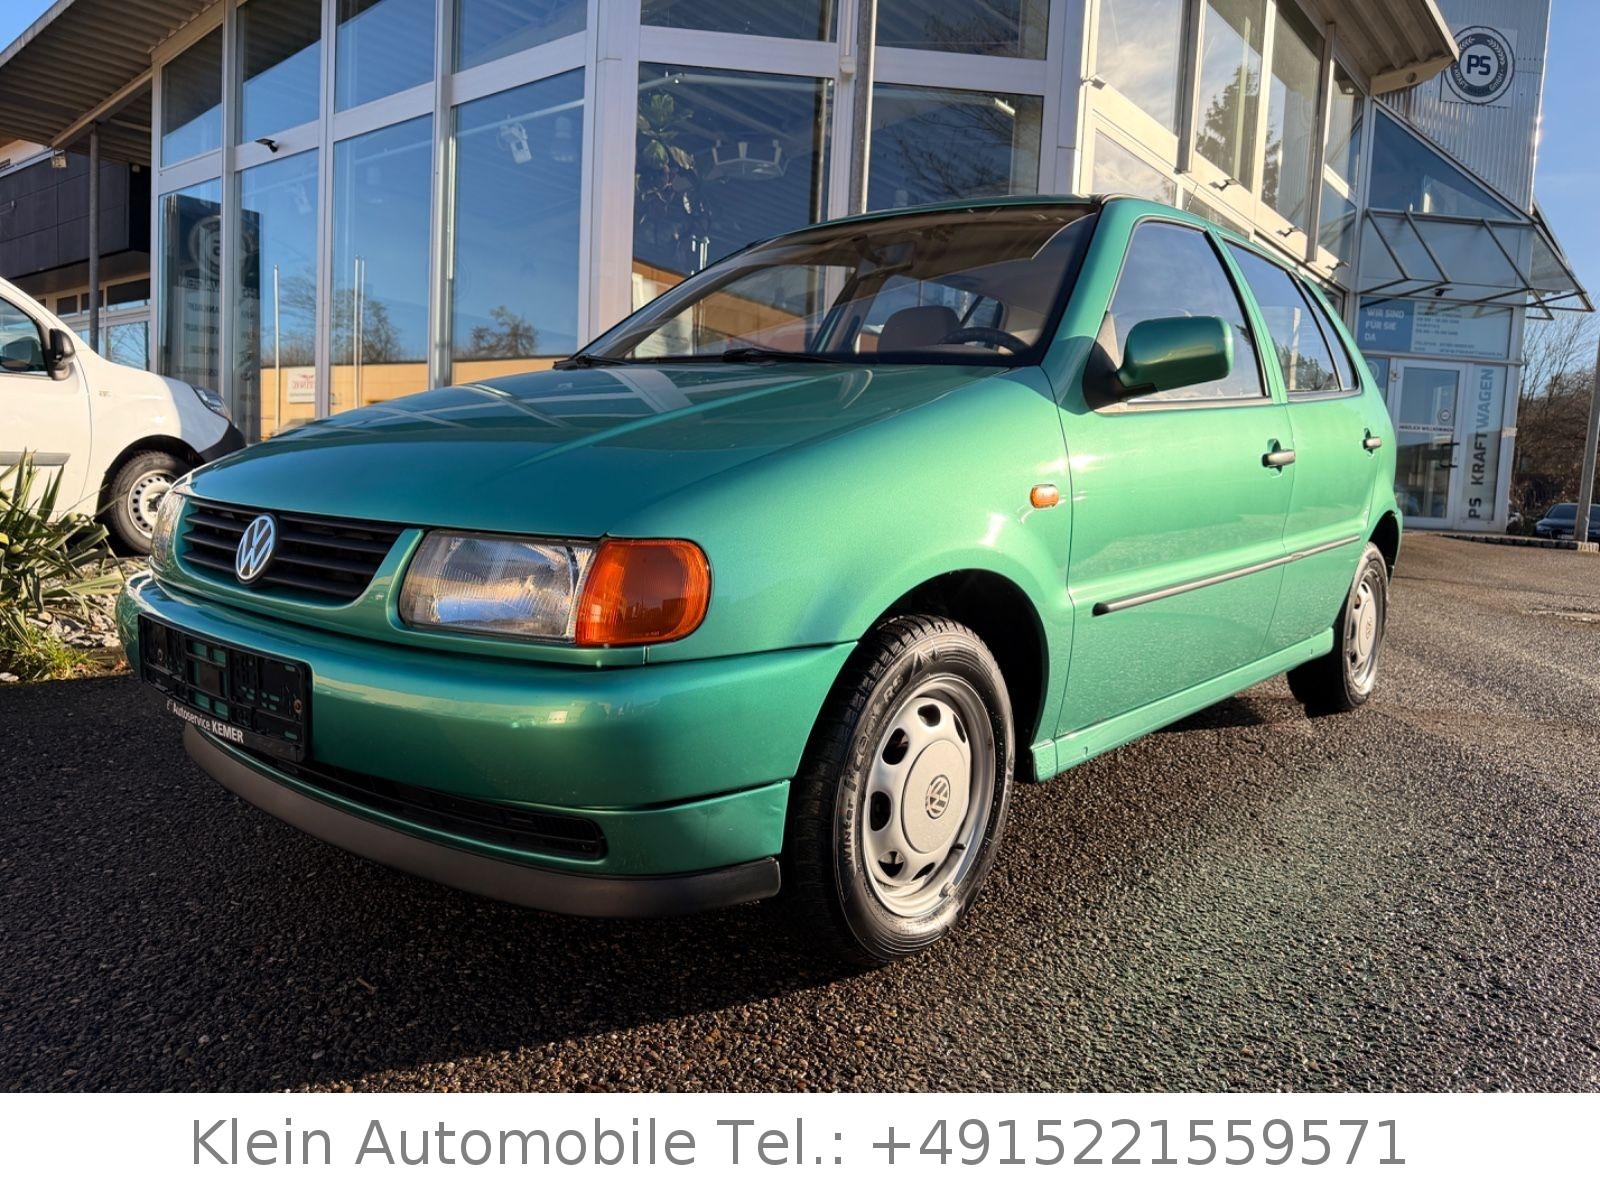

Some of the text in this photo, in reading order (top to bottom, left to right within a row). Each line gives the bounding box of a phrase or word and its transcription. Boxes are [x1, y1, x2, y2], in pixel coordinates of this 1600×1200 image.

[1467, 54, 1491, 75] PS
[1367, 307, 1384, 318] WIR
[1385, 309, 1405, 319] SIND
[1365, 319, 1397, 331] FÜR SIE
[1364, 332, 1376, 342] DA
[1468, 368, 1494, 520] PS KRAFTWAGEN
[173, 701, 211, 731] Autoservice
[211, 720, 244, 744] KEMER
